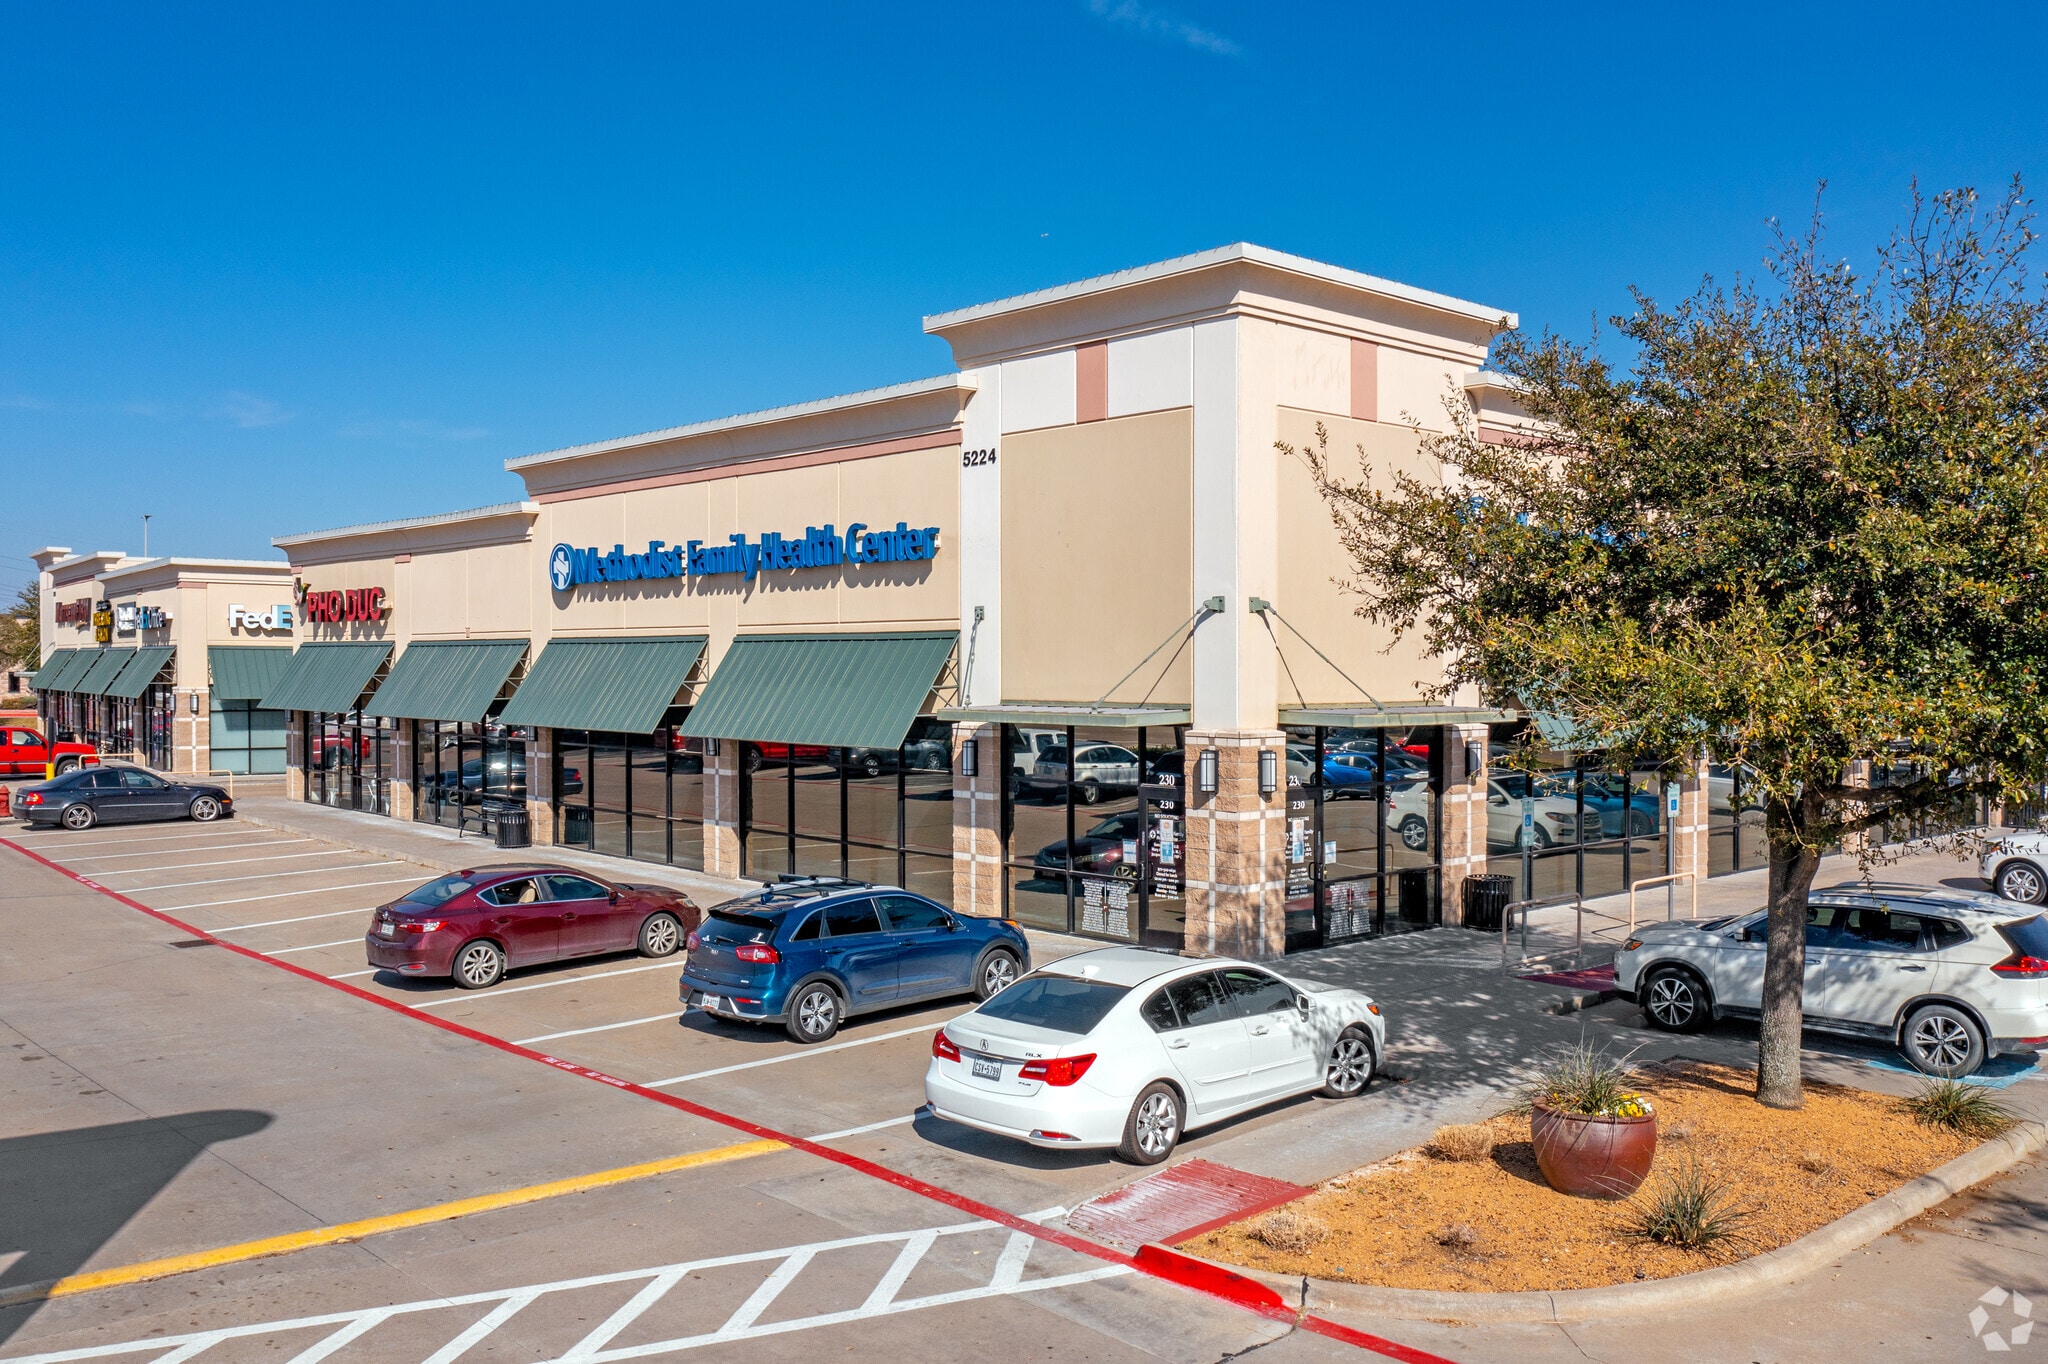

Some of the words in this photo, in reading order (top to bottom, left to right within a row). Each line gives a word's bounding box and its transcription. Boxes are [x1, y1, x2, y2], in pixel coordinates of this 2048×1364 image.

[963, 448, 997, 468] 5224
[575, 540, 684, 584] Methodist
[687, 533, 760, 582] Family
[761, 524, 843, 570] Health
[846, 522, 940, 564] Center
[307, 590, 344, 622] PHO
[345, 586, 386, 622] DUC
[228, 604, 293, 629] FedE
[1159, 774, 1175, 786] 230
[1160, 800, 1174, 809] 230
[1292, 801, 1306, 809] 230
